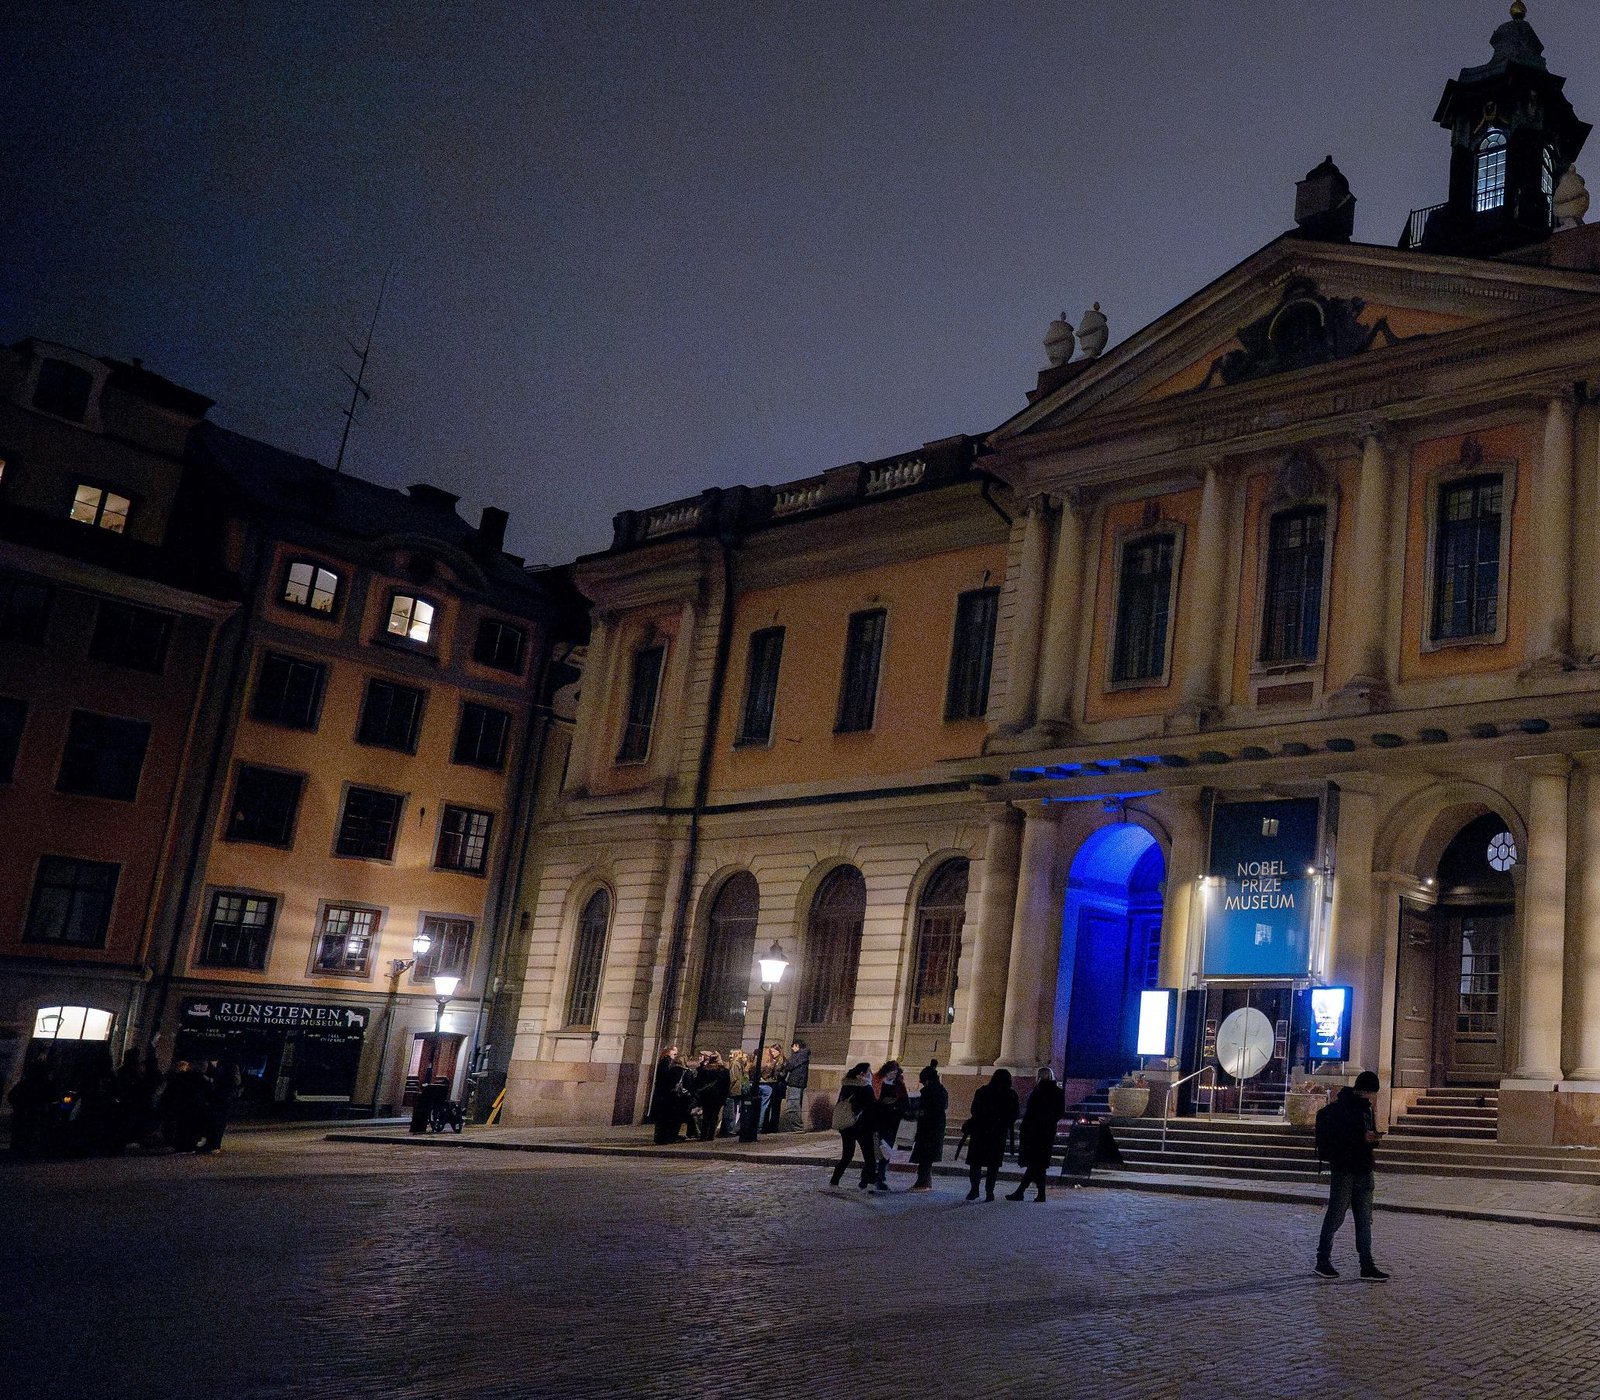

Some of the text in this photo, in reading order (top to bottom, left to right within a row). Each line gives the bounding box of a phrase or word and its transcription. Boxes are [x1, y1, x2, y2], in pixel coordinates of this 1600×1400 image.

[1237, 860, 1288, 877] NOBEL
[1241, 878, 1281, 893] PRIZE
[1224, 893, 1295, 911] MUSEUM
[220, 1002, 341, 1020] RUNSTENEN
[214, 1014, 342, 1027] WOODEN HORSE MUSEUM
